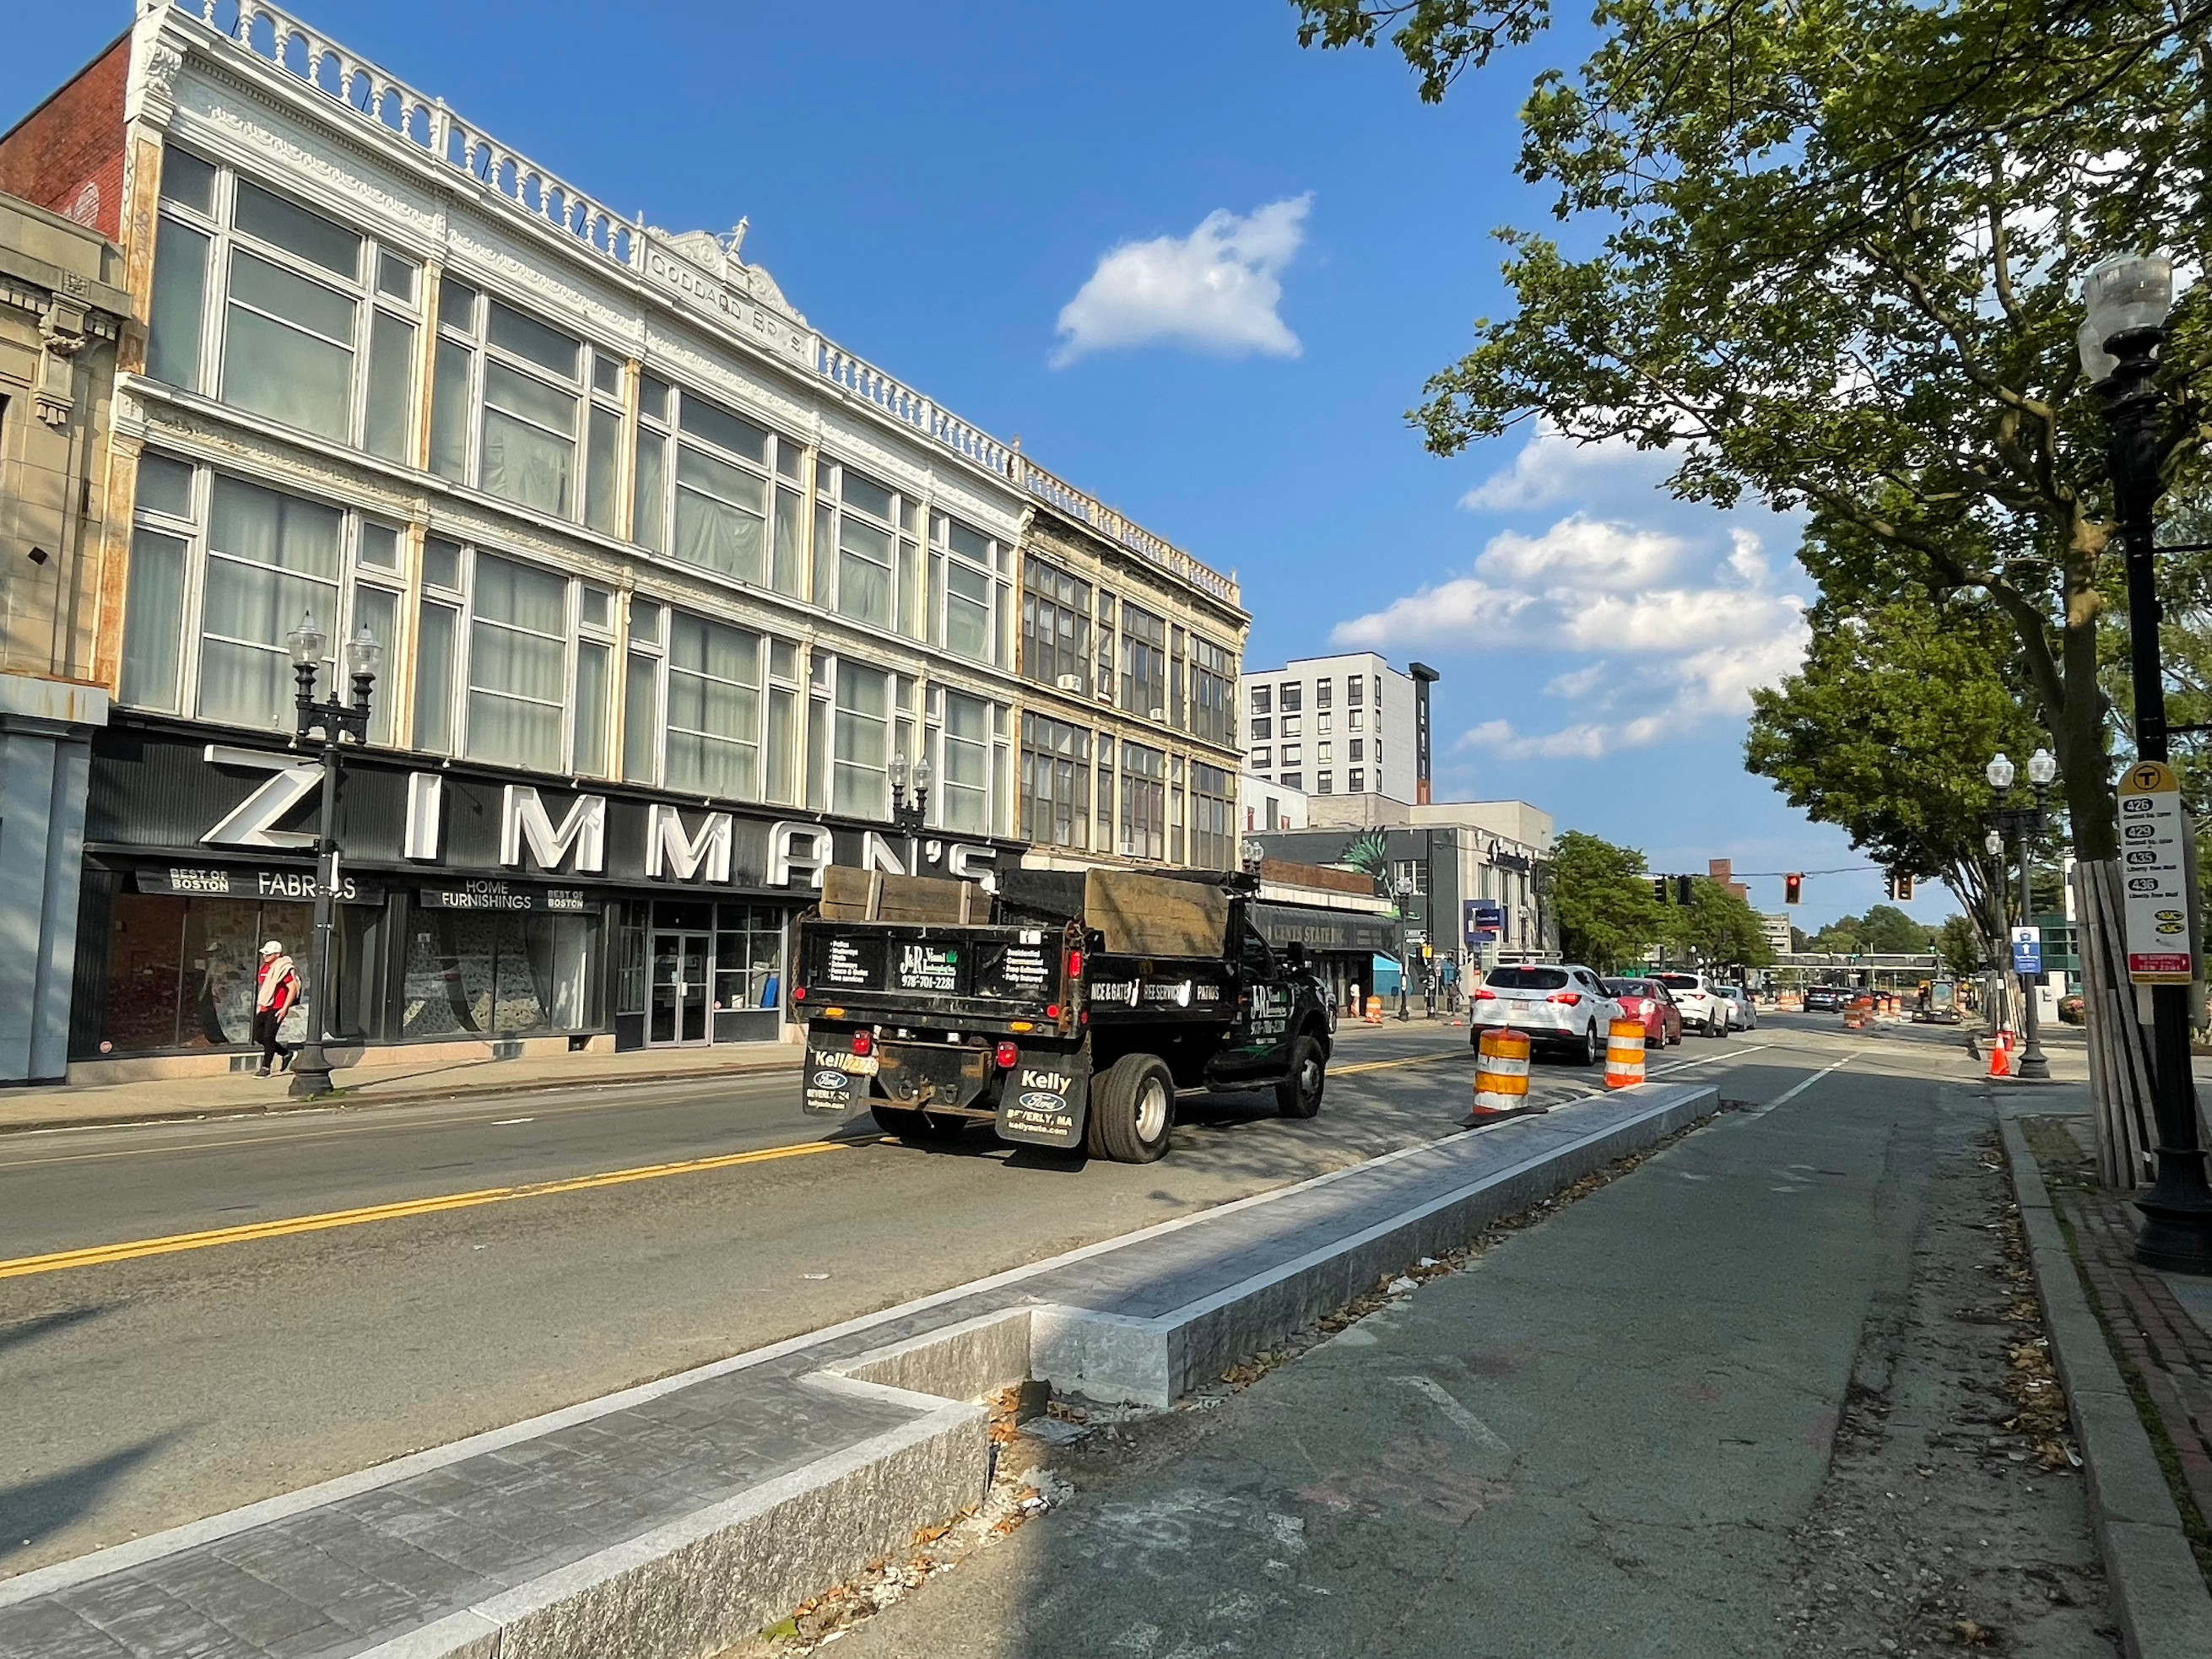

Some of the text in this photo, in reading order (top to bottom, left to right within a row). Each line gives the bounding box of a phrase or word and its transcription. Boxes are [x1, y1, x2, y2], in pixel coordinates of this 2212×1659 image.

[652, 254, 804, 355] GODDARD BRS.
[2137, 771, 2155, 786] T
[2127, 799, 2150, 810] 426
[199, 743, 999, 895] ZIMMAN'S
[2128, 826, 2152, 837] 429
[2130, 852, 2153, 862] 435
[170, 868, 228, 881] BEST OF
[171, 878, 230, 893] BOSTON
[257, 872, 356, 900] FABRS
[466, 880, 509, 894] HOME
[2132, 878, 2155, 889] 436
[441, 892, 532, 909] FURNISHINGS
[548, 889, 584, 900] BEST OF
[548, 898, 584, 910] BOSTON
[901, 975, 955, 990] 978-701-2281
[1091, 983, 1130, 1001] NCE & GATE
[1143, 984, 1155, 1000] REE
[1197, 985, 1220, 1001] PATIOS
[815, 1051, 846, 1069] Kell
[1021, 1069, 1072, 1095] Kelly
[1006, 1108, 1073, 1127] BEVERLY, MA
[1008, 1121, 1068, 1136] kellyauto.com
